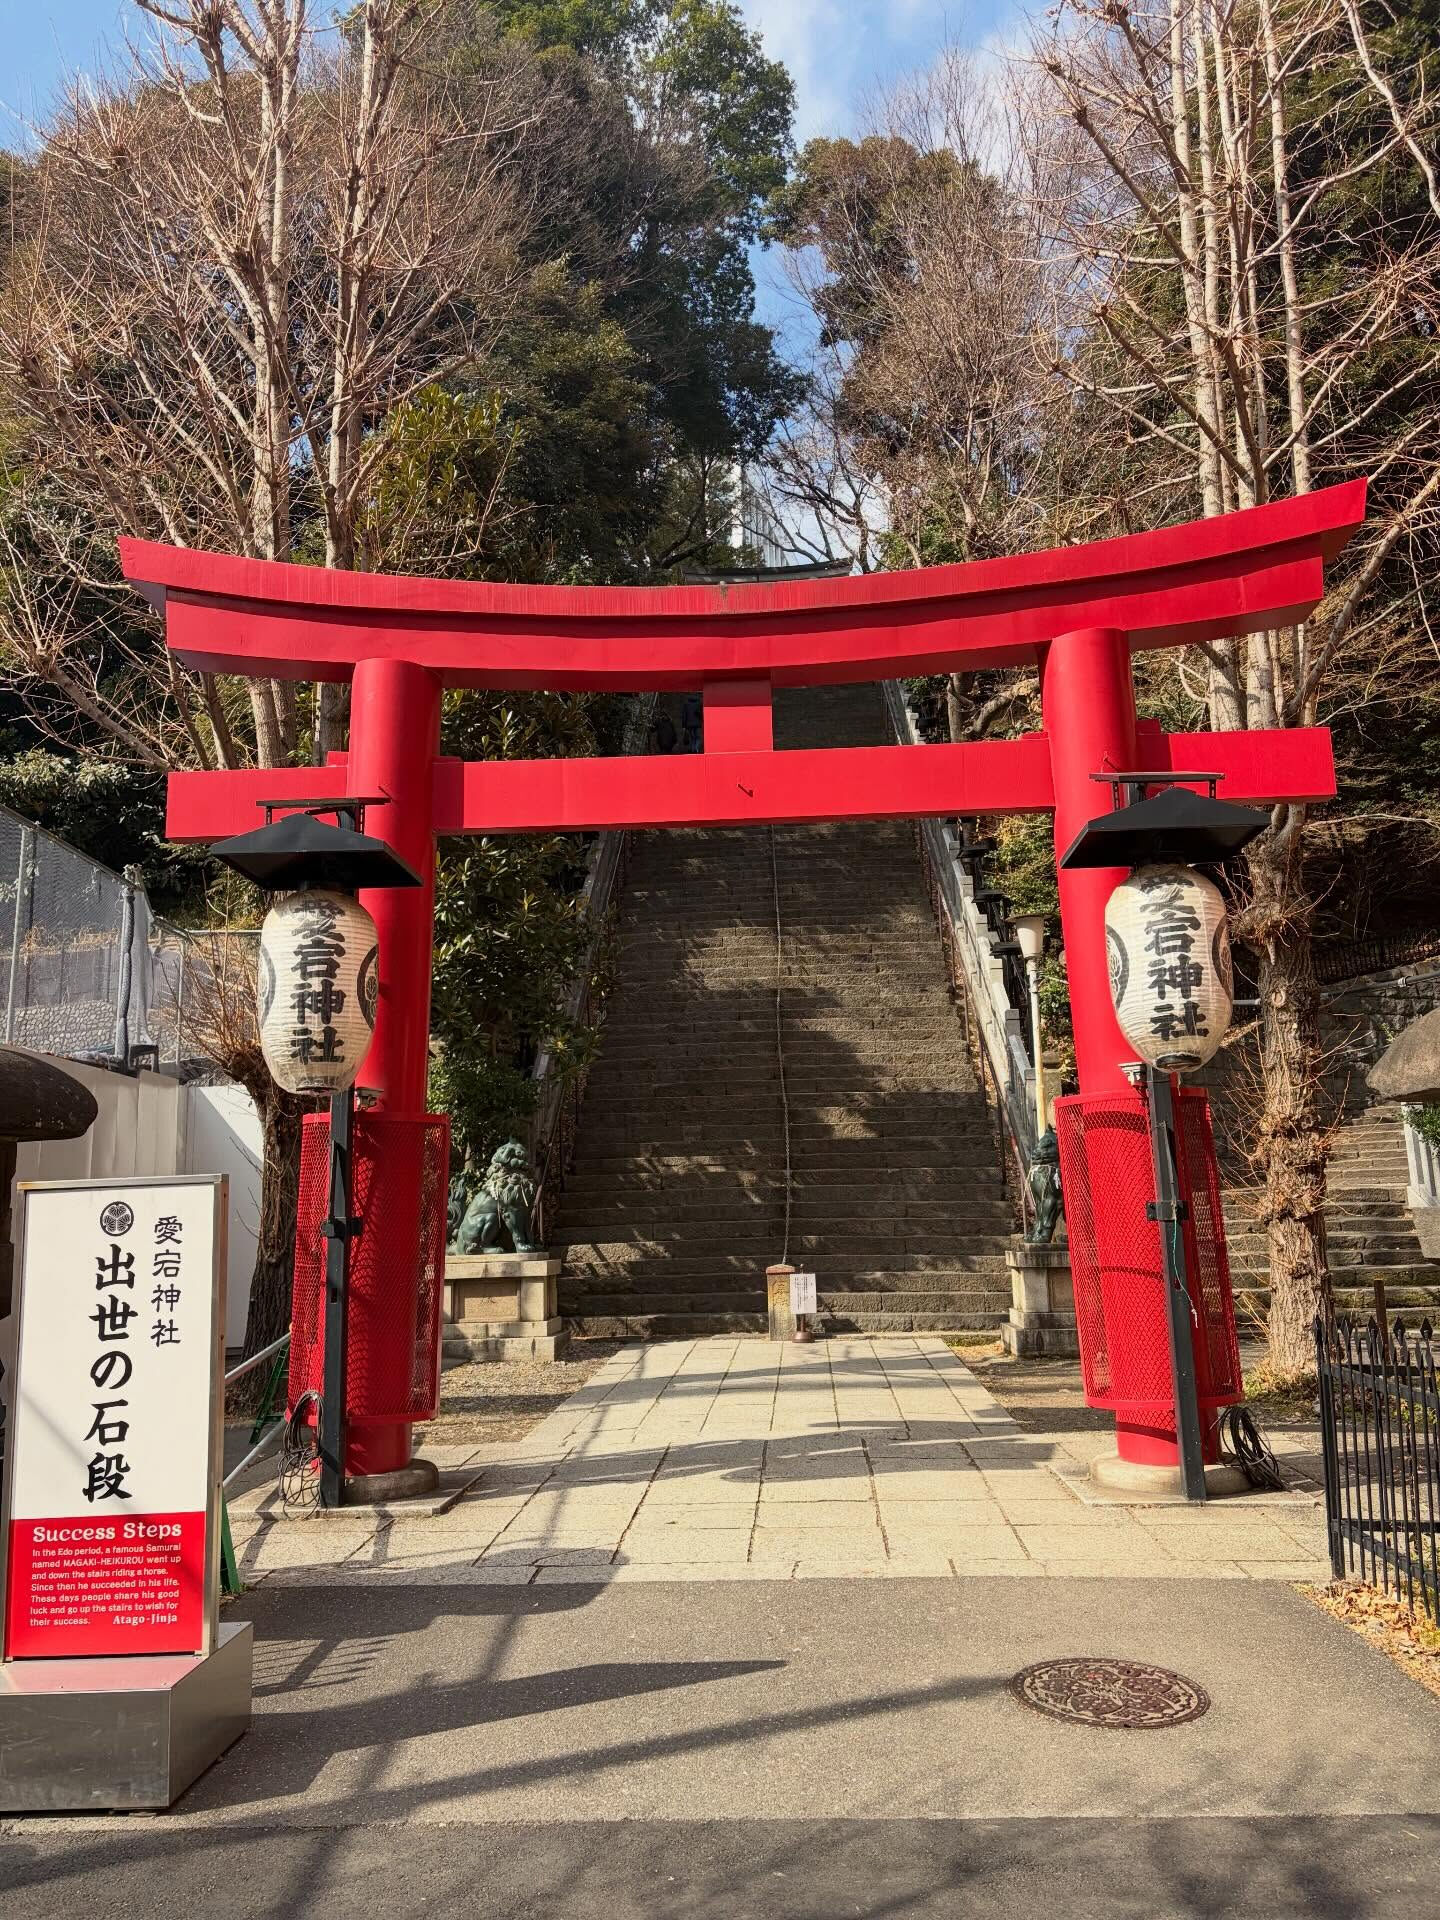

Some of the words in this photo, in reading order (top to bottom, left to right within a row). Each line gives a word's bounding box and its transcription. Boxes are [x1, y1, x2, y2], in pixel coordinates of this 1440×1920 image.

[1140, 875, 1209, 1042] 愛宕神社
[290, 899, 347, 1065] 愛宕神社
[150, 1215, 183, 1348] 愛宕神社
[82, 1243, 138, 1503] 出世の石段
[33, 1527, 115, 1542] Success
[123, 1522, 182, 1539] Steps
[146, 1543, 181, 1552] Samurai
[32, 1560, 60, 1568] named
[64, 1557, 143, 1567] MAGAKI-HEIKUROU
[91, 1580, 135, 1588] succeeded
[164, 1578, 179, 1586] life.
[59, 1594, 79, 1602] days
[82, 1593, 111, 1602] people
[114, 1592, 139, 1600] share
[158, 1590, 179, 1599] good
[31, 1607, 47, 1615] luck
[145, 1602, 164, 1610] wish
[30, 1618, 50, 1626] their
[53, 1618, 90, 1626] success.
[113, 1613, 177, 1626] Atago-Jinja
